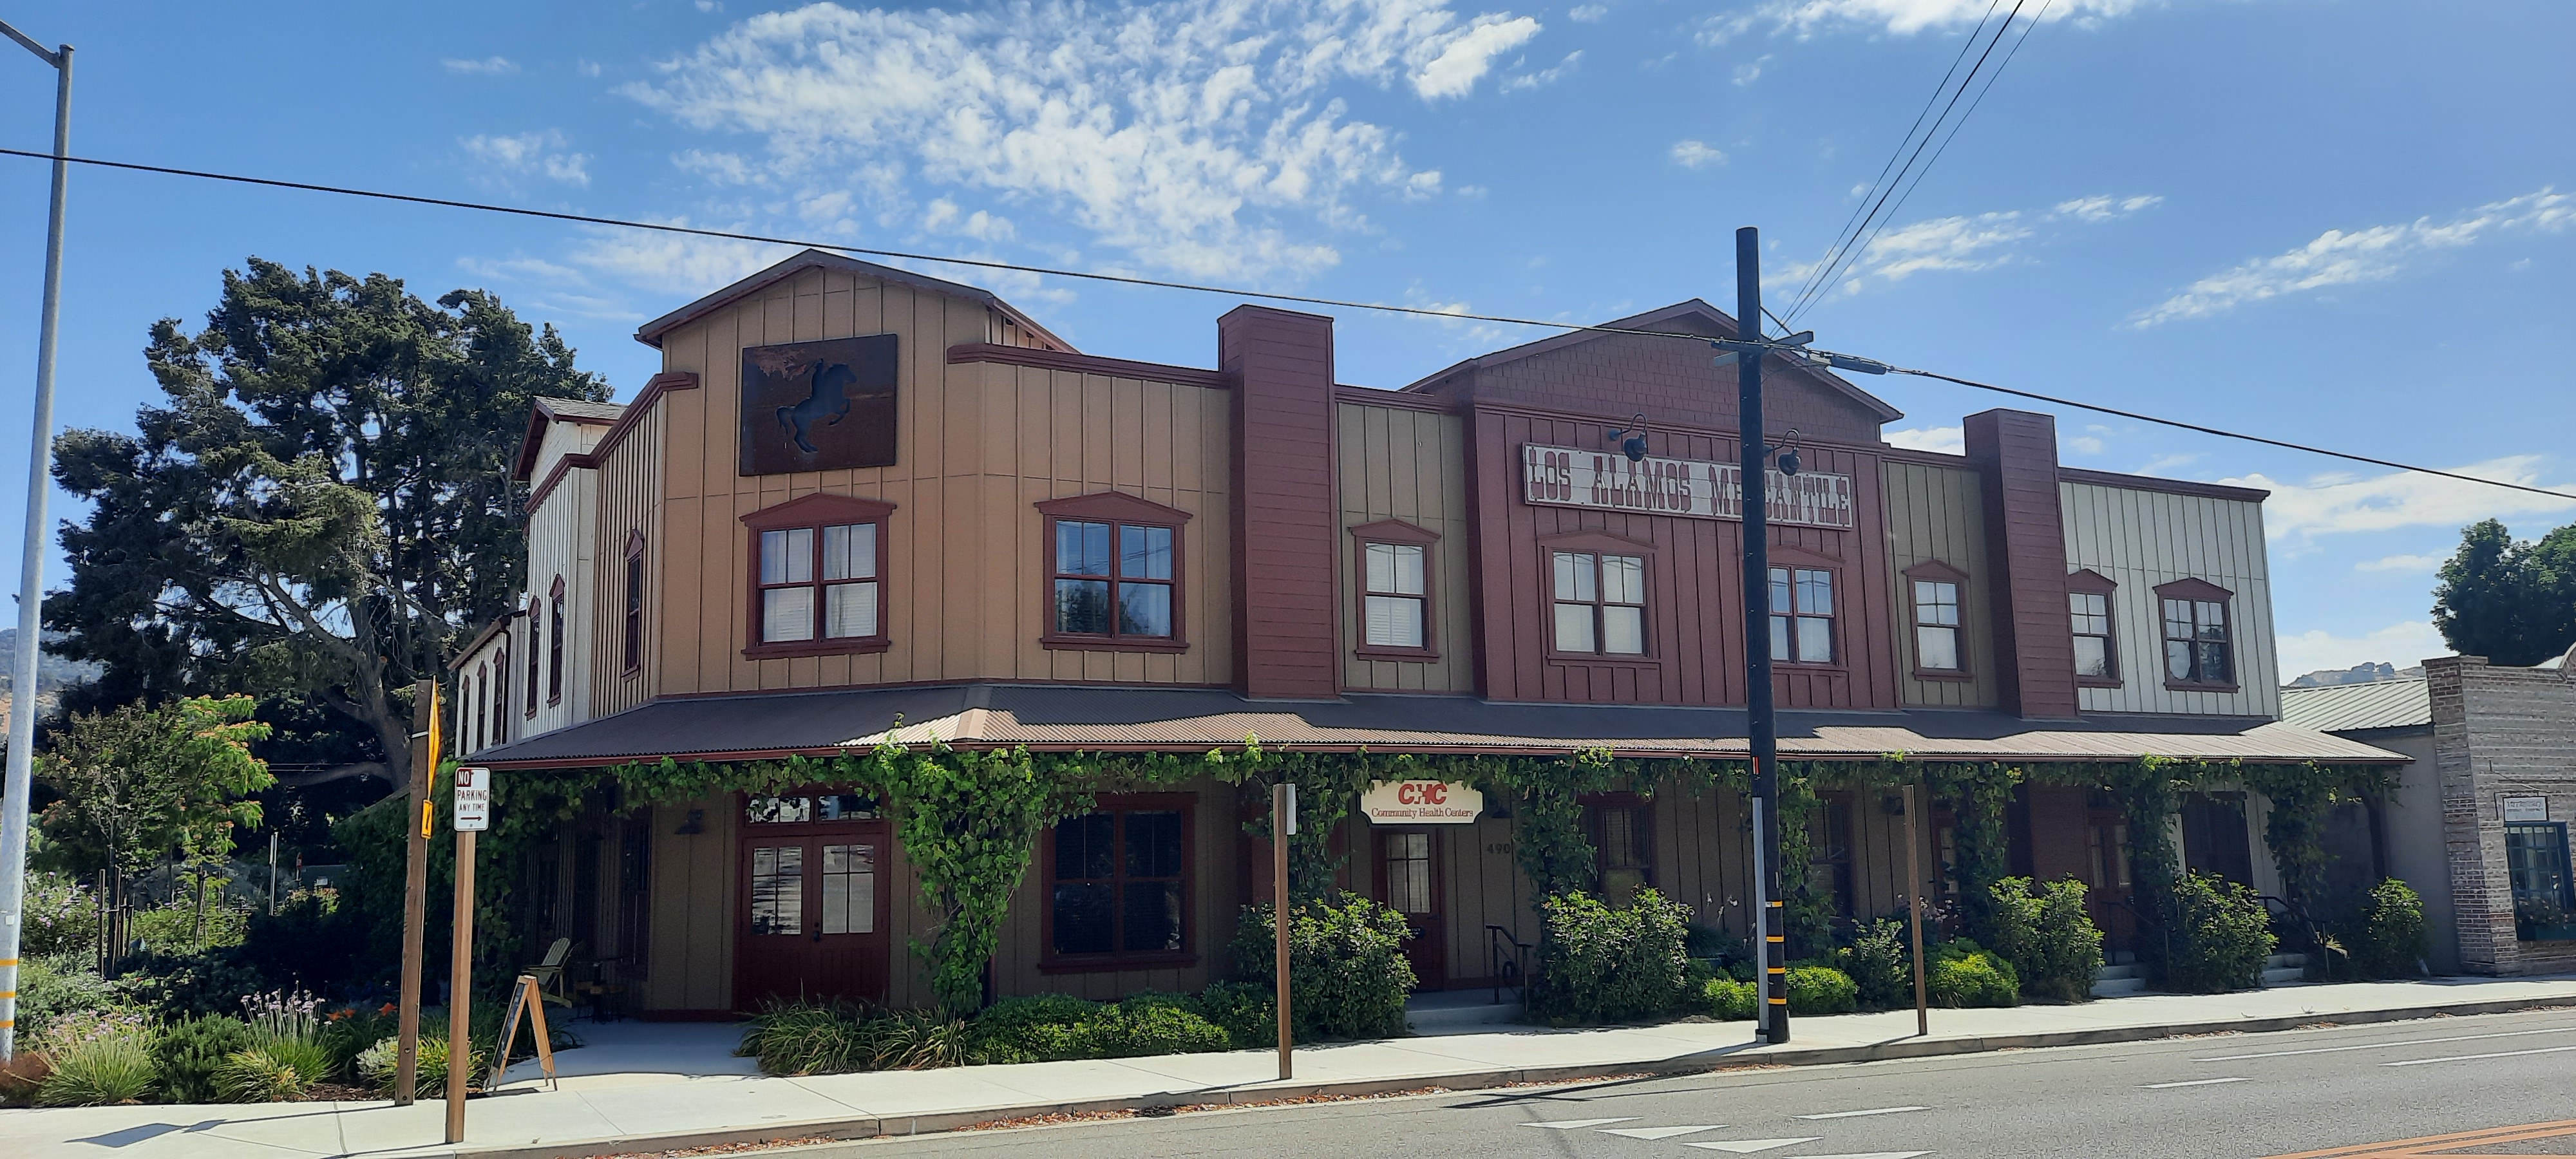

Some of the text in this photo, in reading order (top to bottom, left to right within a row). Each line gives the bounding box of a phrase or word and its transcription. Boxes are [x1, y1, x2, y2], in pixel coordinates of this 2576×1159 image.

[1529, 449, 1851, 525] LOS ALAMOS MEANTILE
[458, 771, 469, 785] NO
[457, 789, 487, 801] PARKING
[1398, 784, 1447, 804] CHC
[459, 804, 485, 812] ANY TIME
[1371, 807, 1473, 819] Community Health Centers
[1487, 843, 1511, 854] 490
